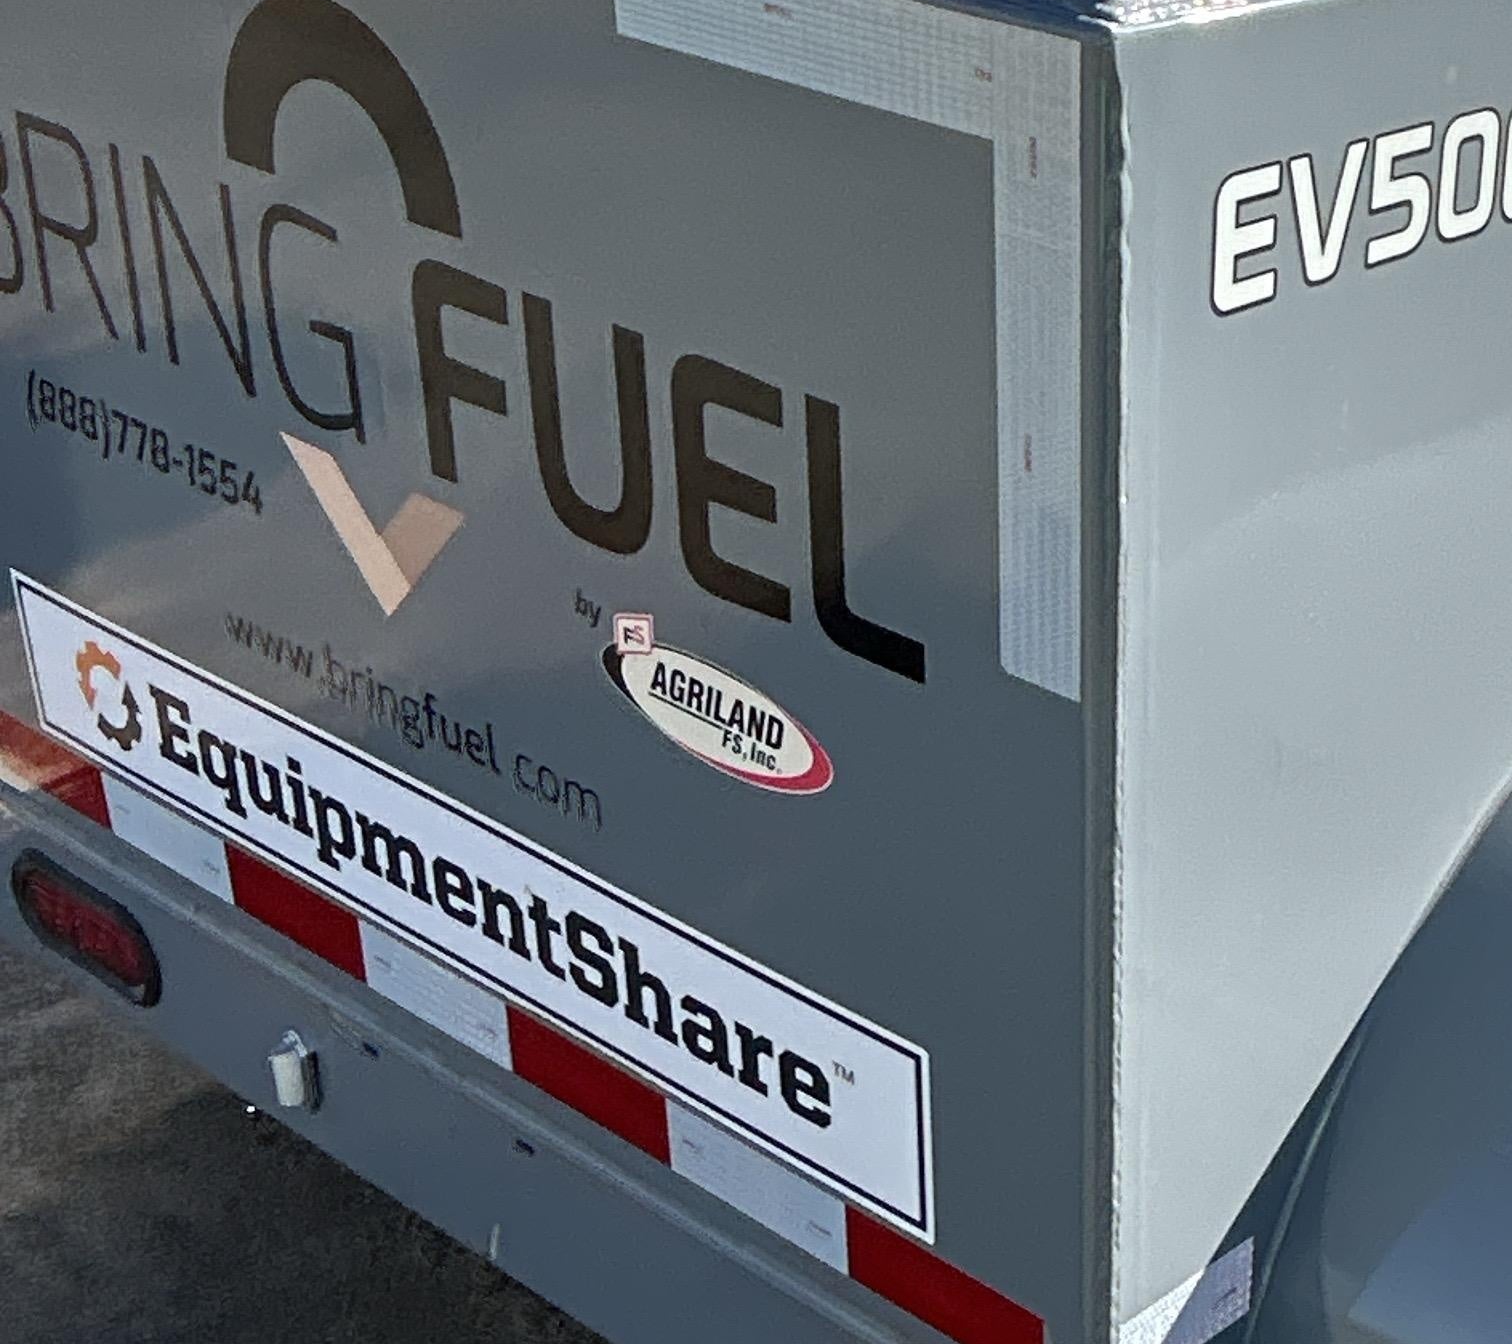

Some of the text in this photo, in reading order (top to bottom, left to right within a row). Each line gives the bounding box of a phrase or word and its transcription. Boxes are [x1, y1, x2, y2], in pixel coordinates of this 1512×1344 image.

[0, 110, 367, 445] RING
[412, 258, 926, 685] FUEL
[574, 587, 602, 629] by
[224, 611, 604, 833] www.bringfuelcom
[651, 661, 785, 751] AGRILAND
[148, 682, 832, 1130] EquipmentShare
